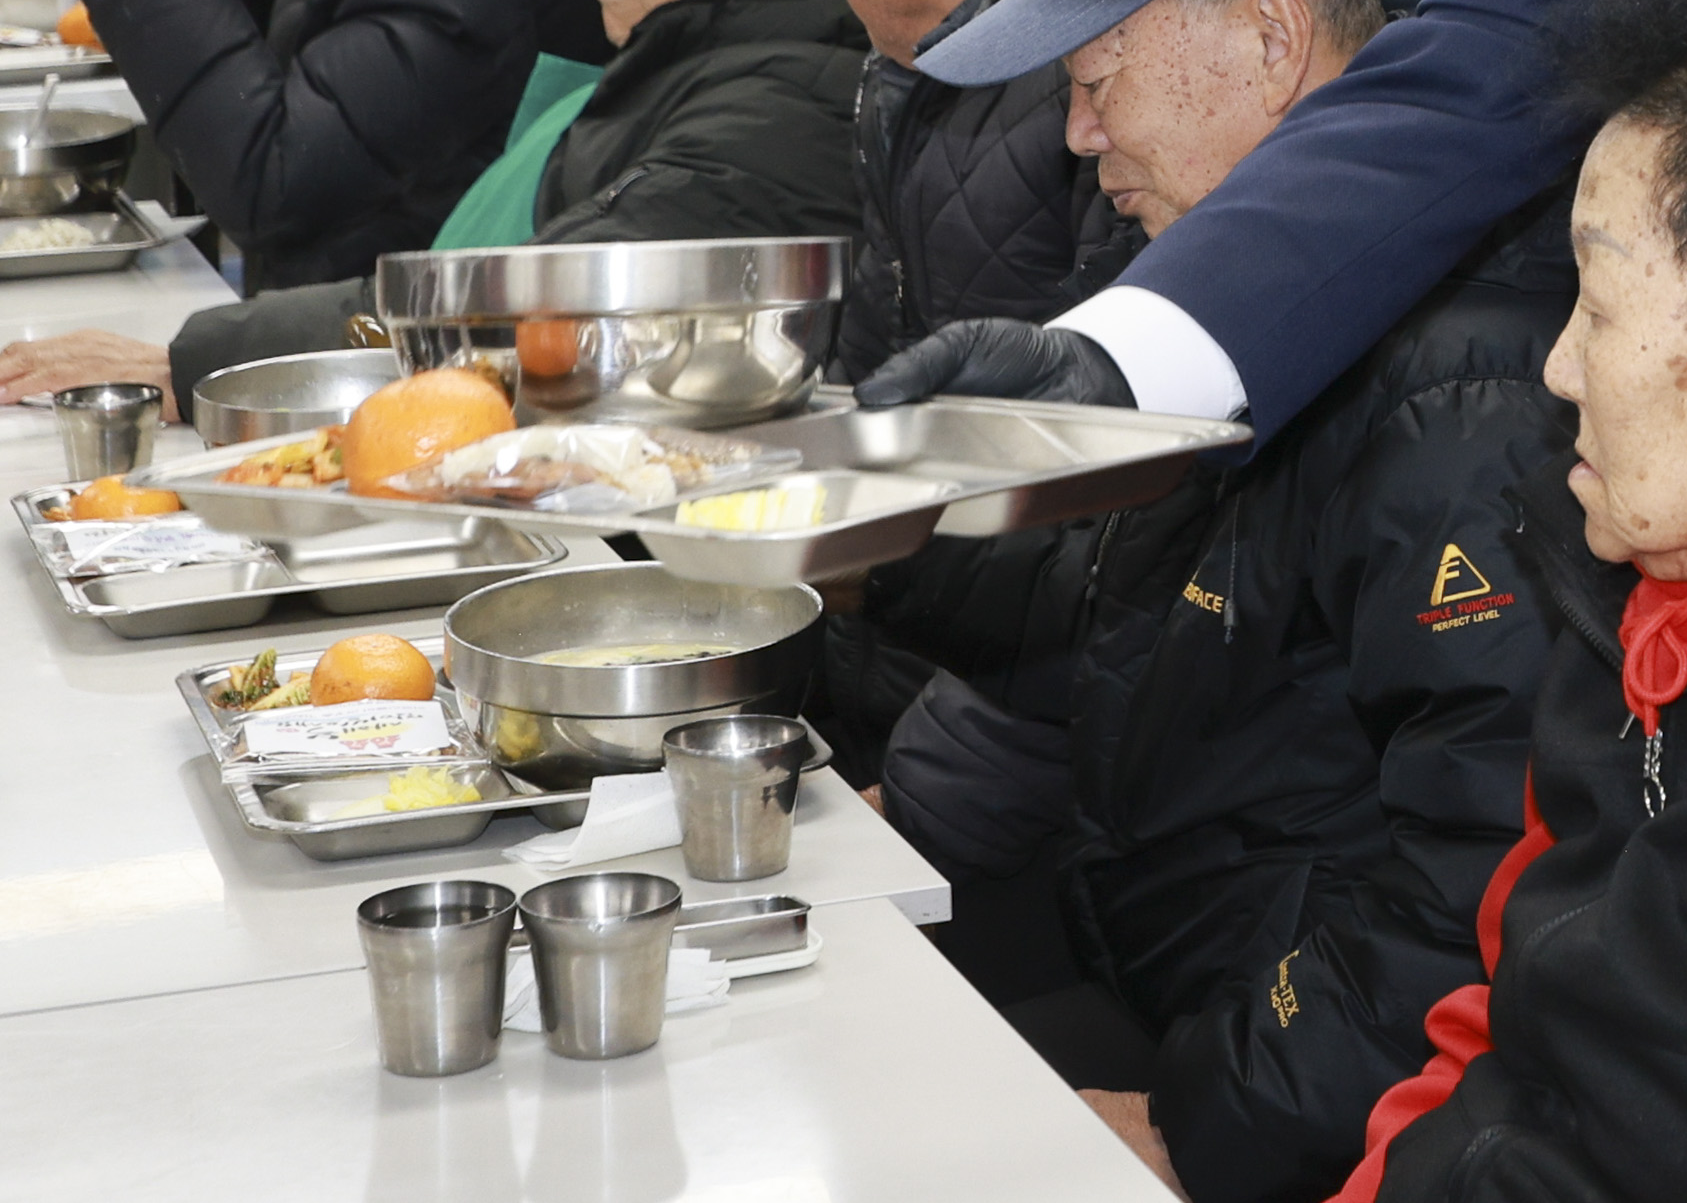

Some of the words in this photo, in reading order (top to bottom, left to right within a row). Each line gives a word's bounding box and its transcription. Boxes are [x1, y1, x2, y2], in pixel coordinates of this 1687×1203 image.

[1416, 606, 1453, 625] TRIPLE
[1457, 593, 1515, 614] FUNCTION
[1432, 615, 1470, 632] PERFECT
[1473, 609, 1500, 623] LEVEL
